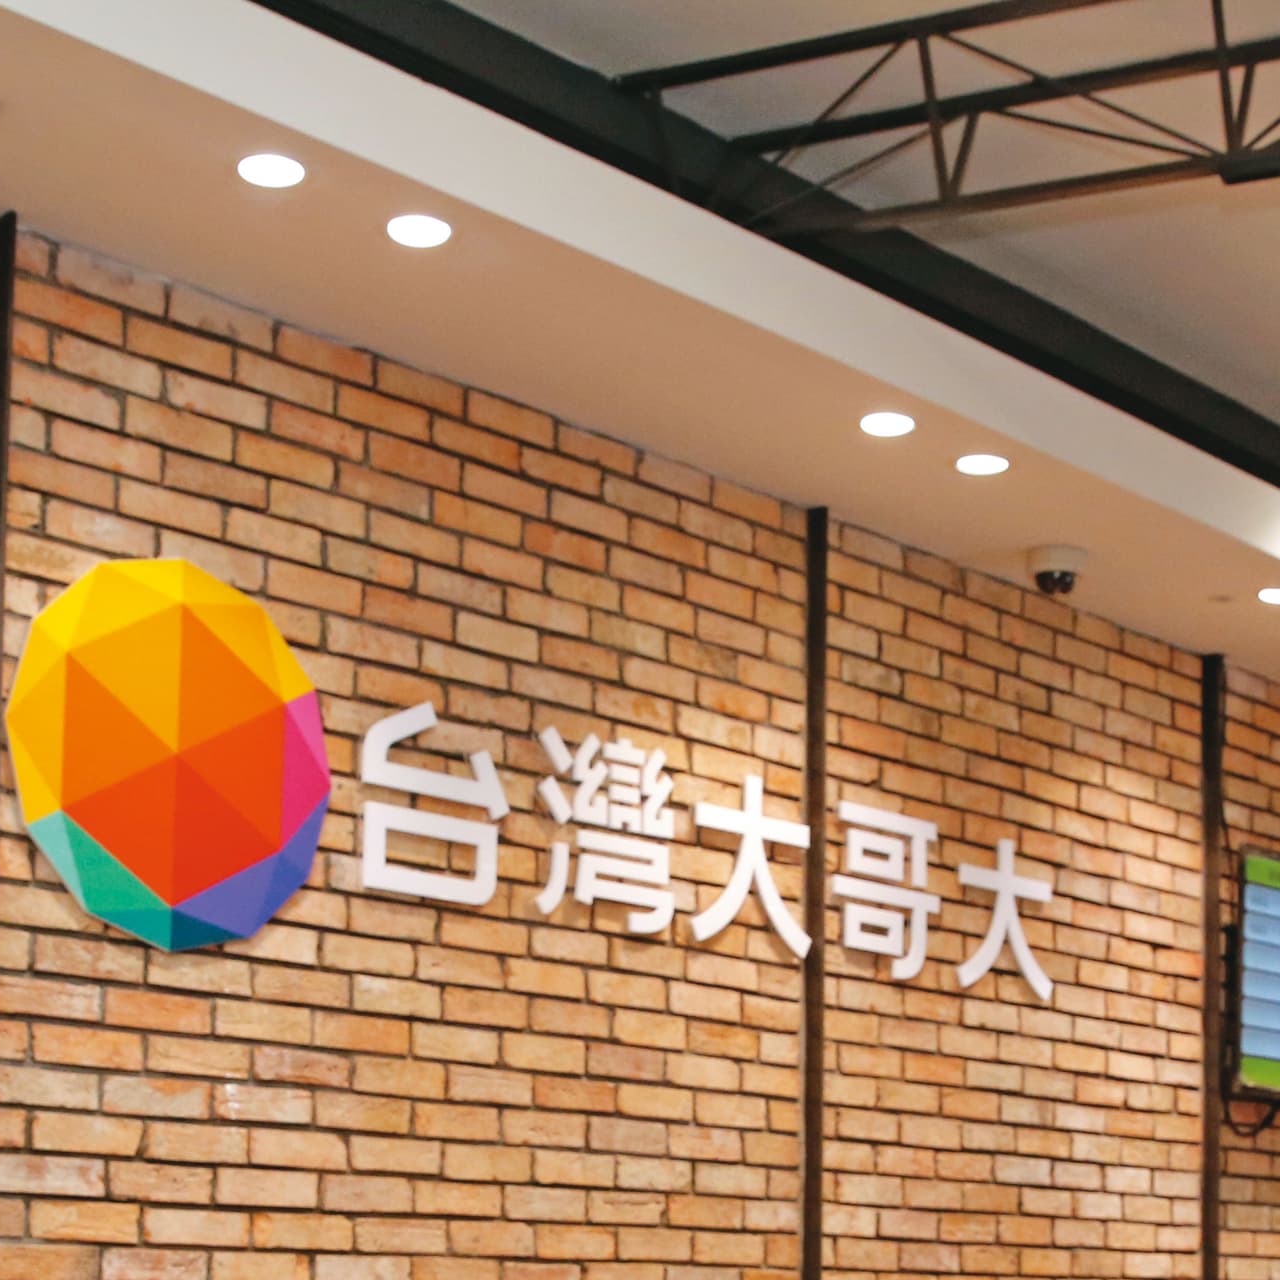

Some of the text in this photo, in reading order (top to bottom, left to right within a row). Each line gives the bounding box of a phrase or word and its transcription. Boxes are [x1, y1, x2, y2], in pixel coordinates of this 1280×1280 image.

[361, 701, 1054, 1000] 台灣大哥大
